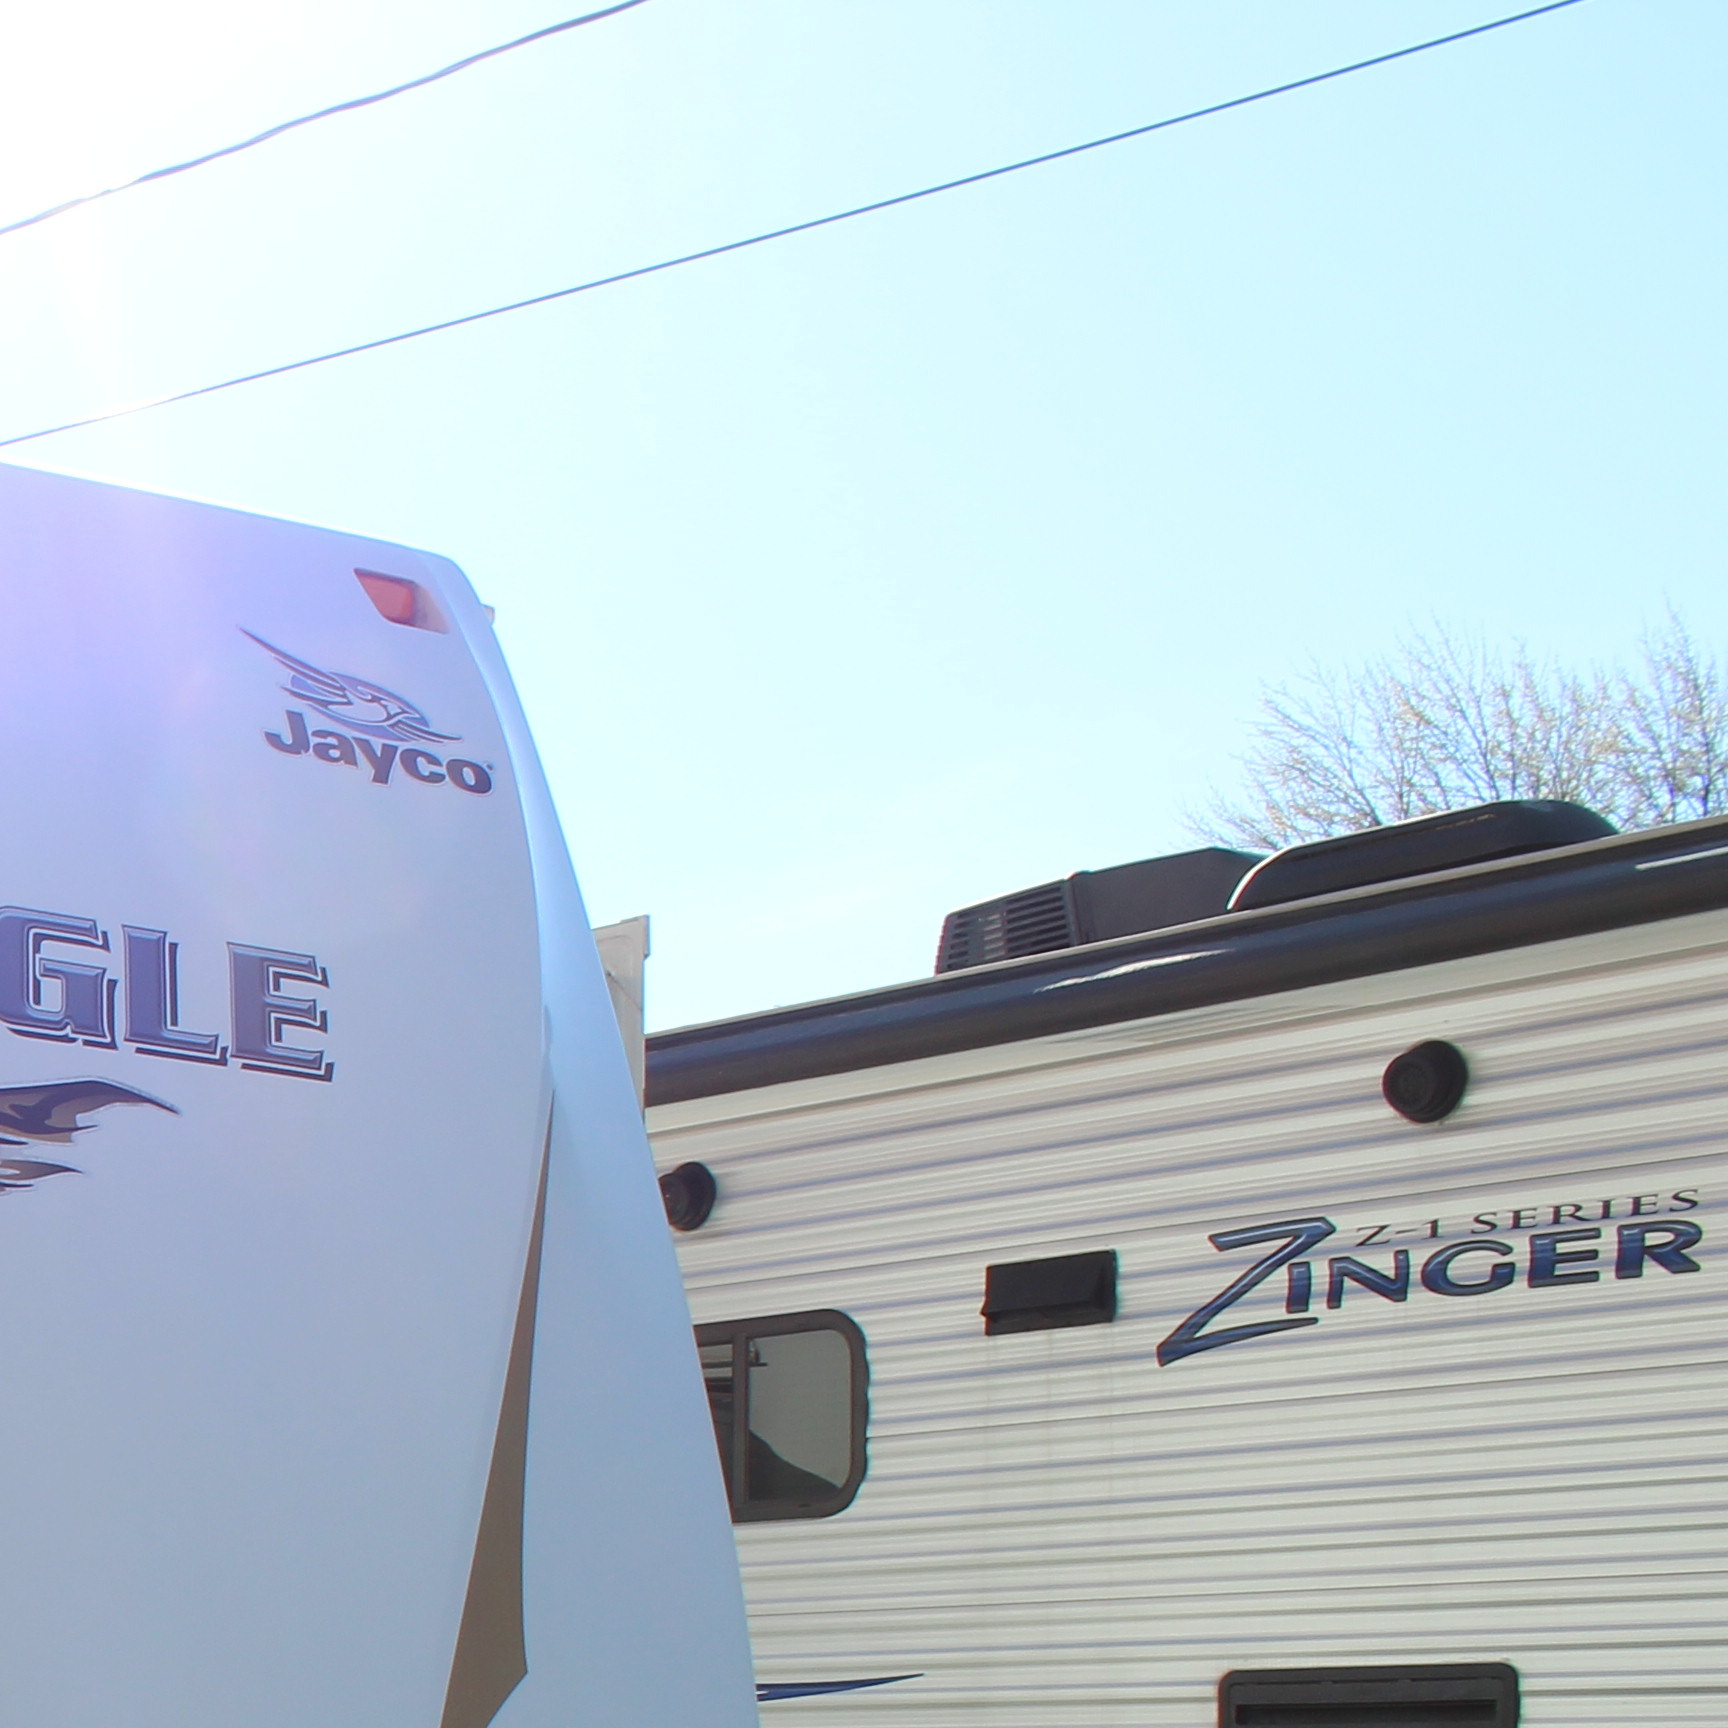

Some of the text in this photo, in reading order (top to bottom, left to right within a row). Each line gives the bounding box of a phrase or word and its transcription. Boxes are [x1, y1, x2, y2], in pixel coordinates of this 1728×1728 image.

[263, 708, 493, 796] Jayco
[1355, 1188, 1701, 1247] Z-1 SERIES
[1156, 1215, 1703, 1368] ZINGER
